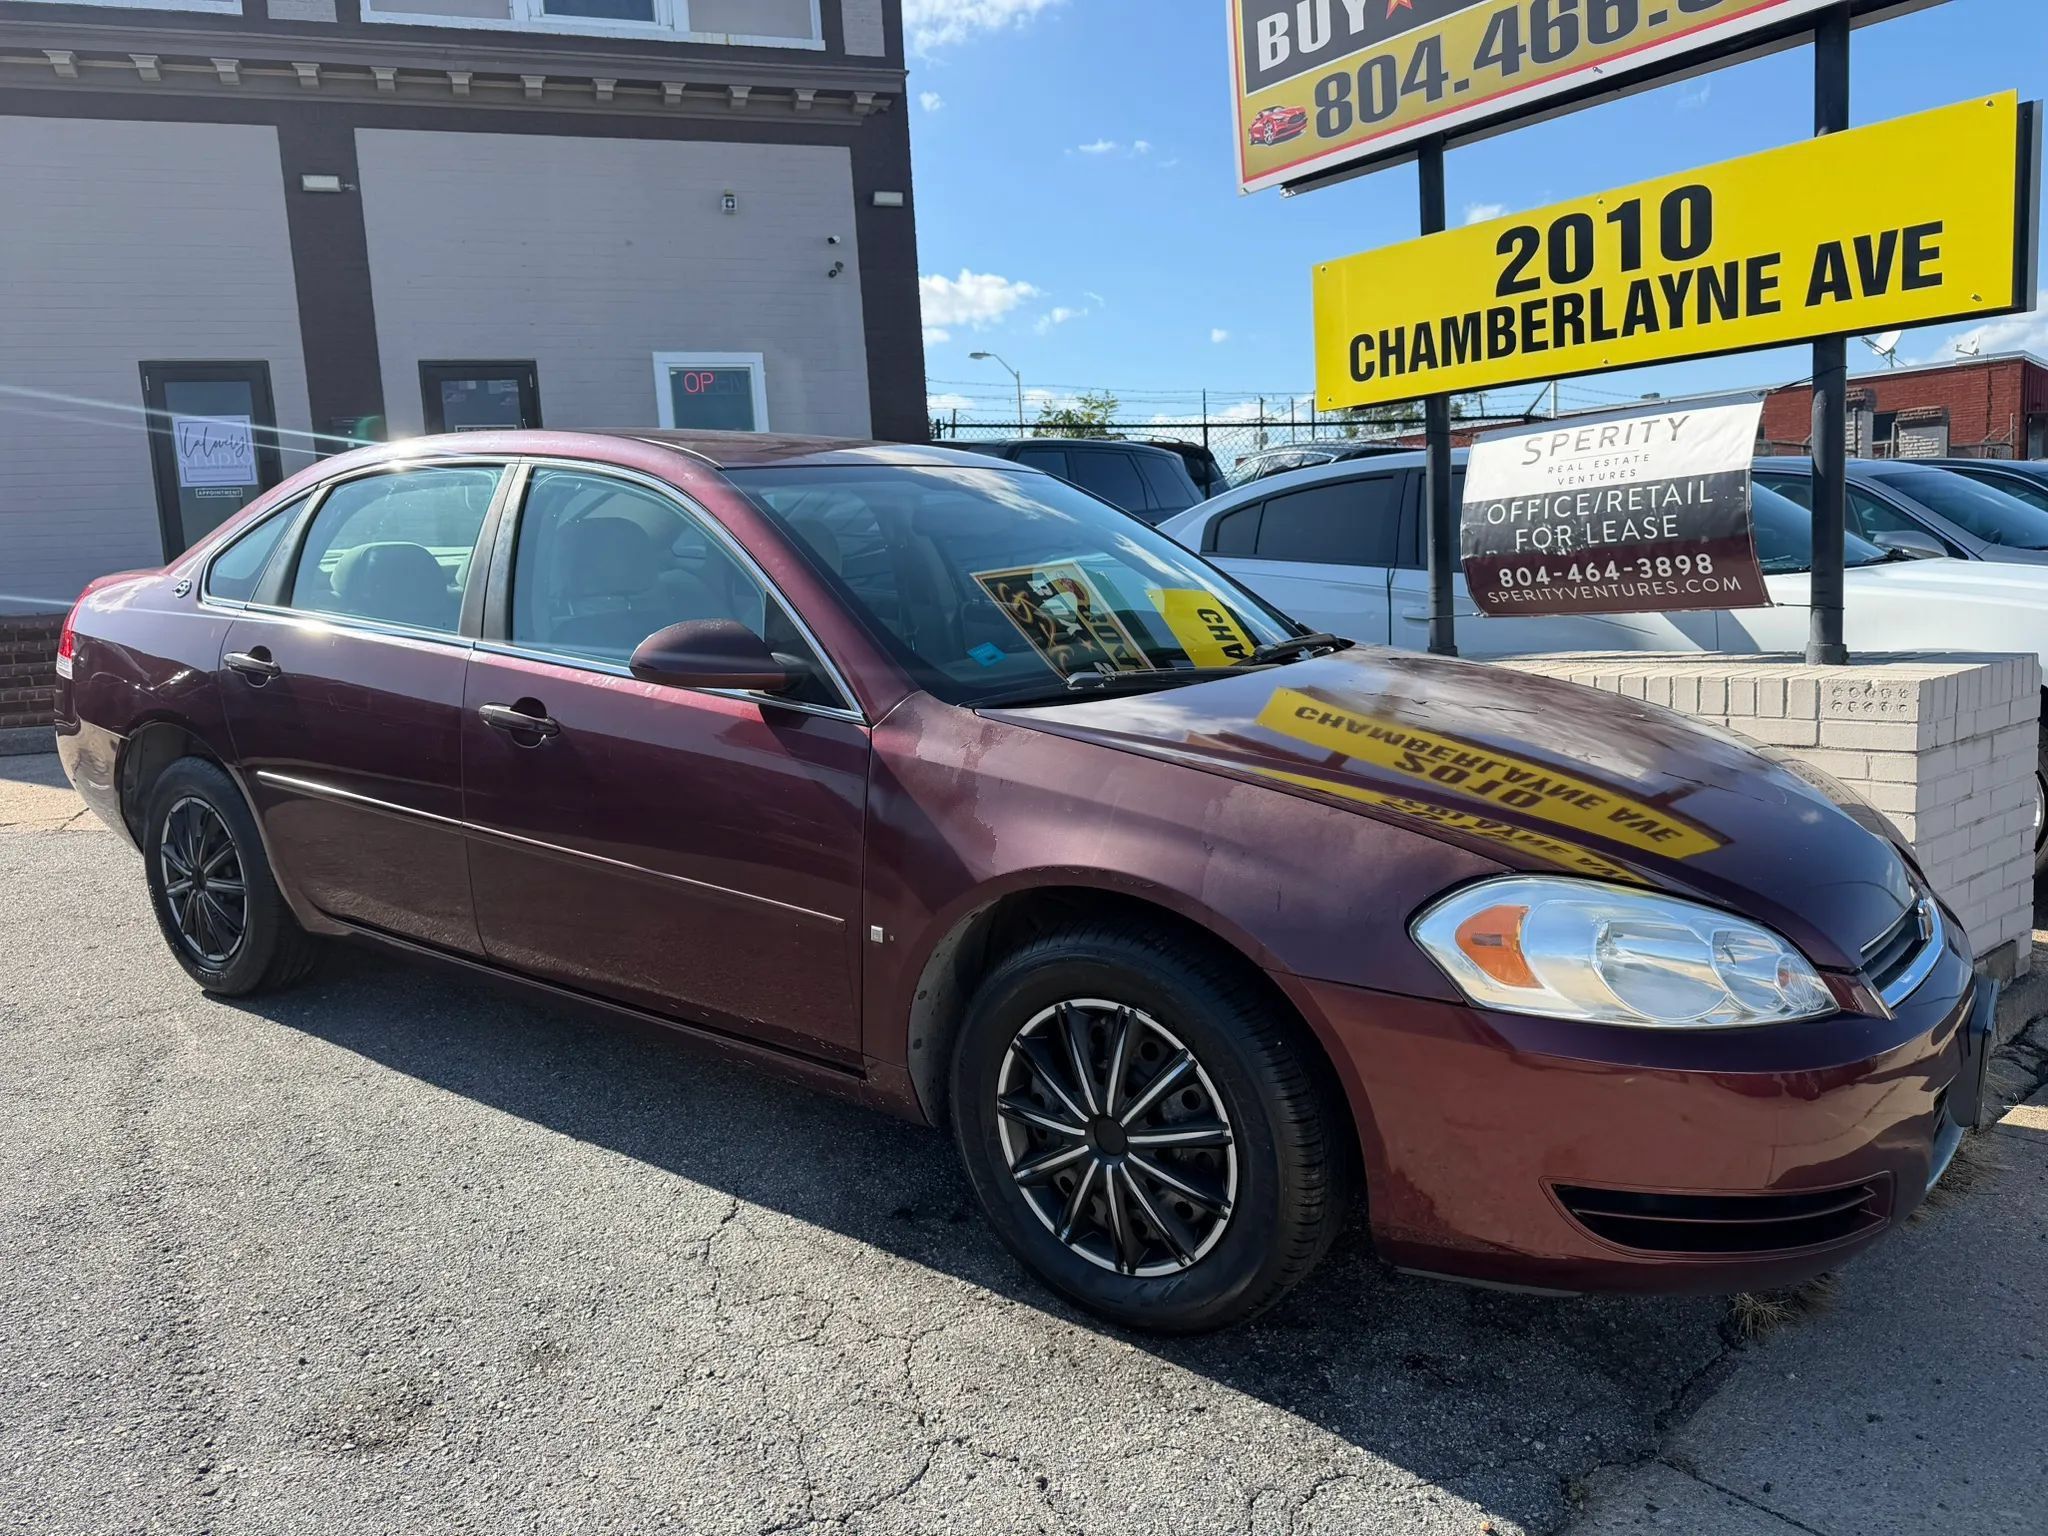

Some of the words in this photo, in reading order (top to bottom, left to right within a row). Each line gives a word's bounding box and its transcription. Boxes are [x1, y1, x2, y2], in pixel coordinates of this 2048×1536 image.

[1256, 0, 1367, 72] BUY
[1314, 0, 1723, 139] 804.466.
[1495, 184, 1714, 298] 2010
[1350, 252, 1782, 382] CHAMBERLAYNE
[1805, 220, 1944, 307] AVE
[1521, 415, 1691, 466] SPERITY
[1547, 461, 1583, 475] REAL
[1594, 454, 1651, 469] ESTATE
[1557, 469, 1637, 486] VENTURES
[1487, 480, 1713, 525] OFFICE/RETAIL
[1516, 524, 1572, 550] FOR
[1586, 515, 1679, 544] LEASE
[1488, 576, 1742, 604] SPERITYVENTURES.COM
[1499, 553, 1713, 588] 804-464-3898
